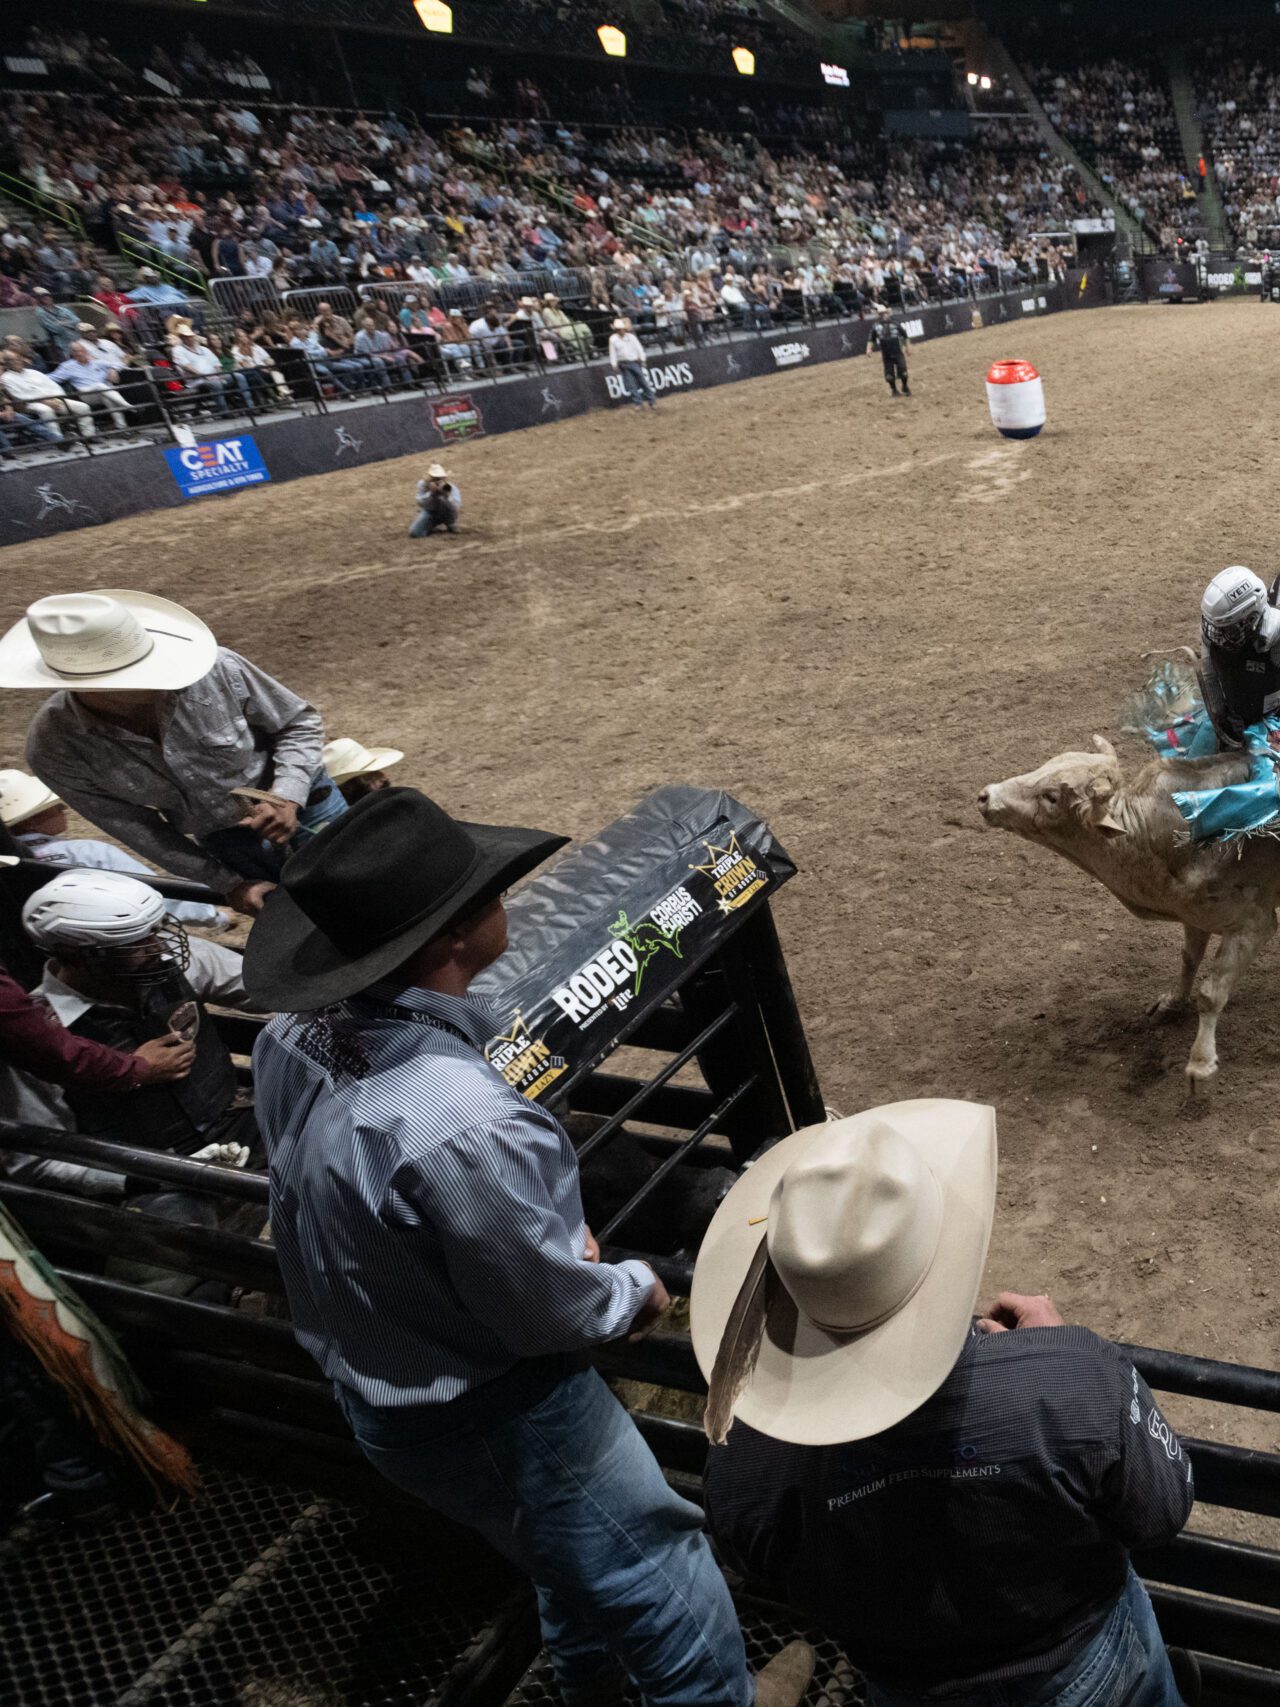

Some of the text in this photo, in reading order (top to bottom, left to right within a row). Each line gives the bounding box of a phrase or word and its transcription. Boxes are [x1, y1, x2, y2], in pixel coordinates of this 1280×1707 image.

[650, 362, 694, 390] DAYS
[180, 440, 245, 471] CEAT
[189, 461, 250, 481] SPECIALTY
[1229, 582, 1251, 600] YETI
[711, 850, 744, 879] TRIPLE
[713, 855, 758, 897] CROWN
[649, 886, 693, 926] CORPUS
[660, 898, 703, 939] CHRISTI
[551, 940, 639, 1025] RODEO
[611, 988, 635, 1012] Lite
[490, 1034, 533, 1073] RIPLE
[521, 1059, 550, 1087] RODEO
[826, 1464, 1001, 1512] PREMIUM FEED SUPPLEMENTS
